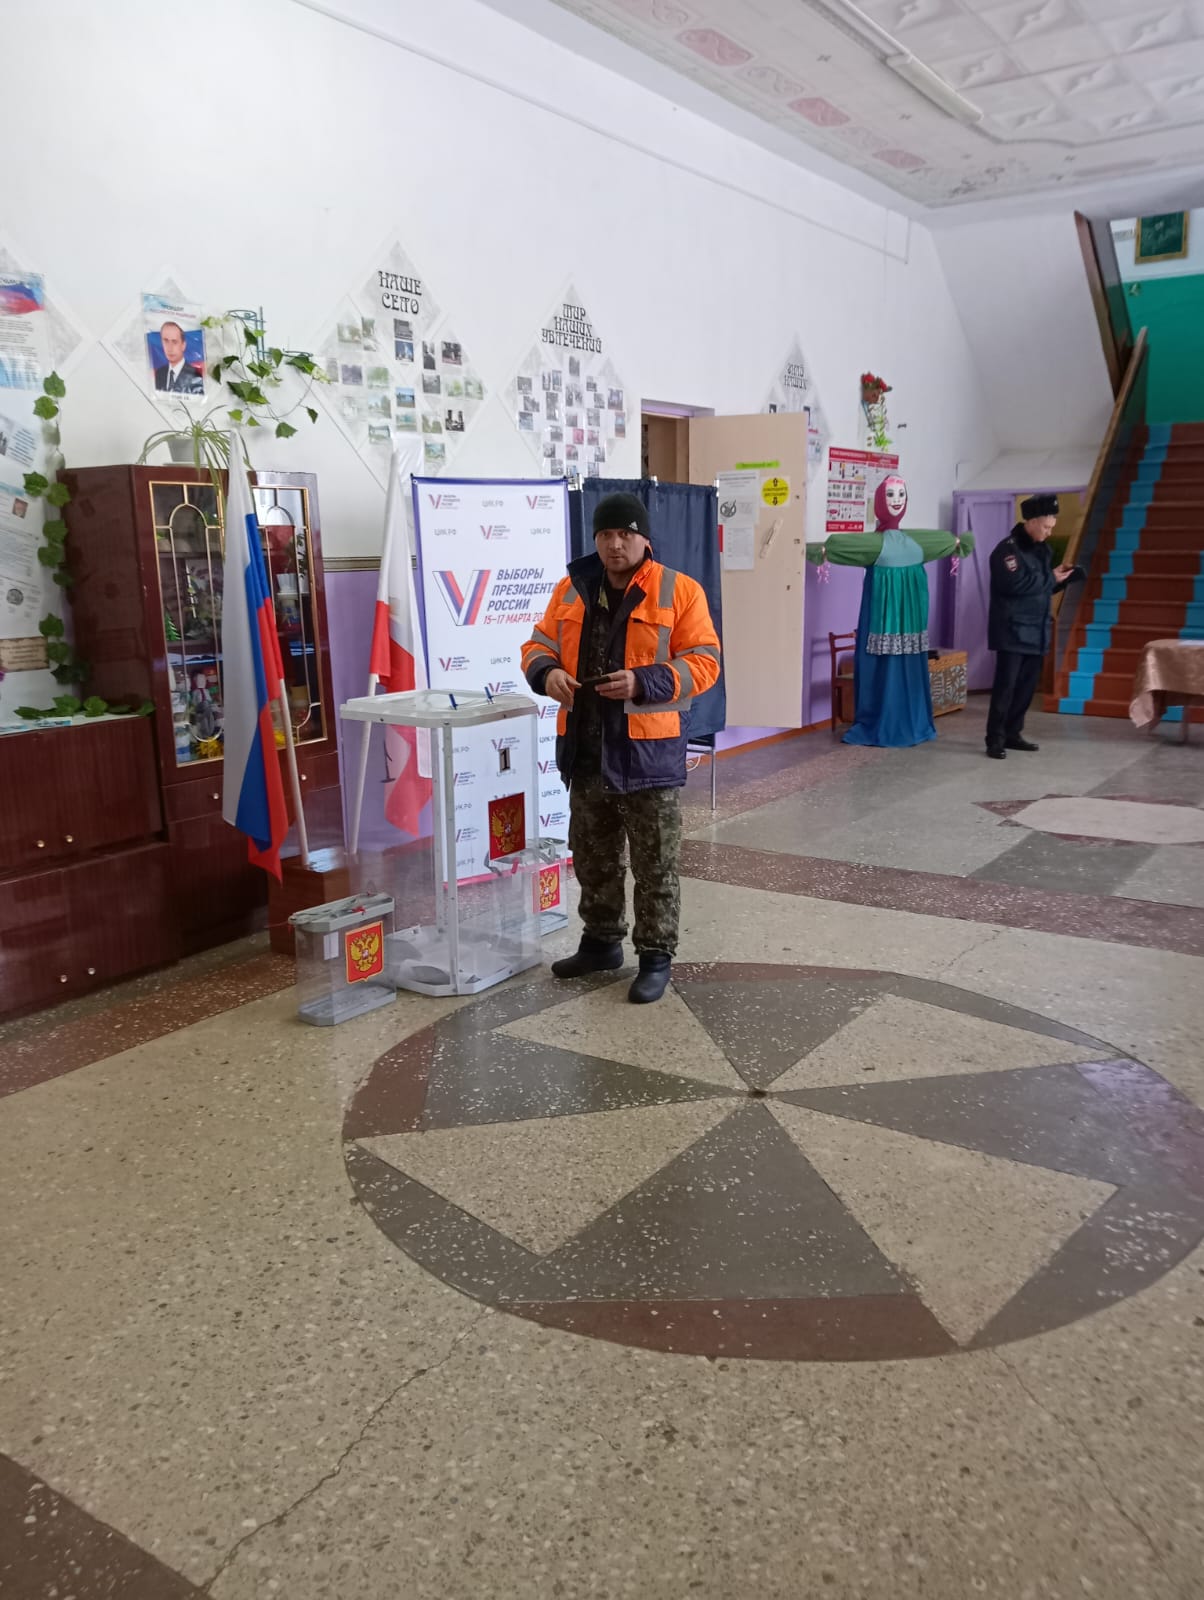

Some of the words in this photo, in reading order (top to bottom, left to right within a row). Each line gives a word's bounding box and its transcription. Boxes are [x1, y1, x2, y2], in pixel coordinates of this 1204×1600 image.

[378, 271, 422, 296] НАШЕ
[554, 316, 592, 337] НАШИХ
[496, 568, 545, 580] ВЫБОРЫ
[487, 599, 530, 612] РОССИИ
[505, 612, 532, 623] МАРТА
[532, 612, 544, 622] 20
